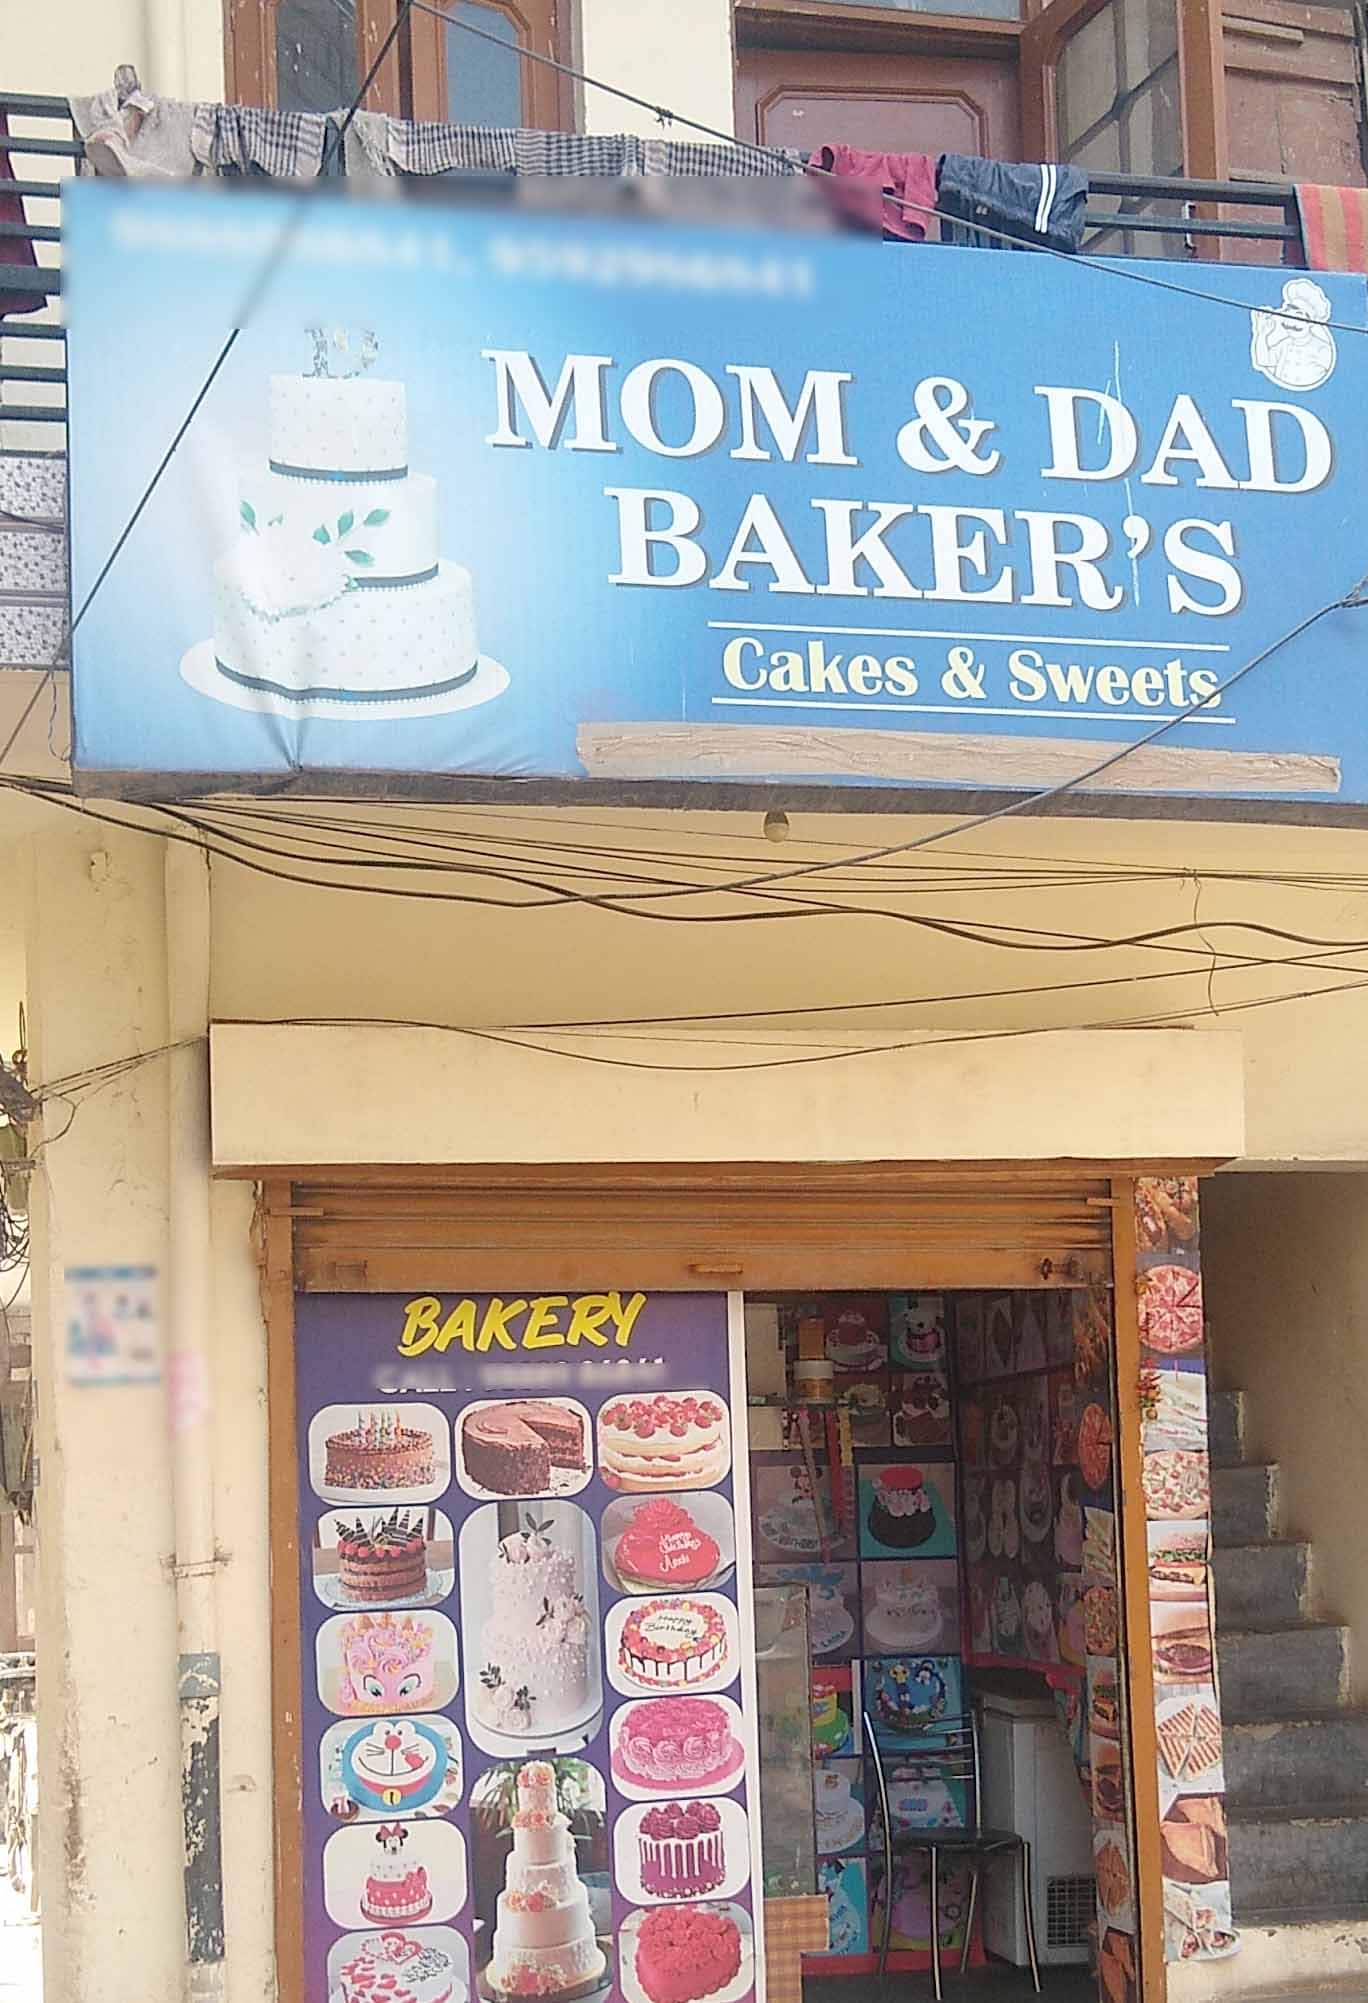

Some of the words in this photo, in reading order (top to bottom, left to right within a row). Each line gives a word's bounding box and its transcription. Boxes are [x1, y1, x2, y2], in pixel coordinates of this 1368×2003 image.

[480, 348, 861, 464] MOM
[895, 375, 1003, 476] &
[1032, 385, 1335, 494] DAD
[602, 485, 1244, 617] BAKER'S
[722, 636, 920, 697] Cakes
[940, 646, 988, 700] &
[1008, 648, 1223, 711] Sweets
[397, 1290, 648, 1357] BAKERY
